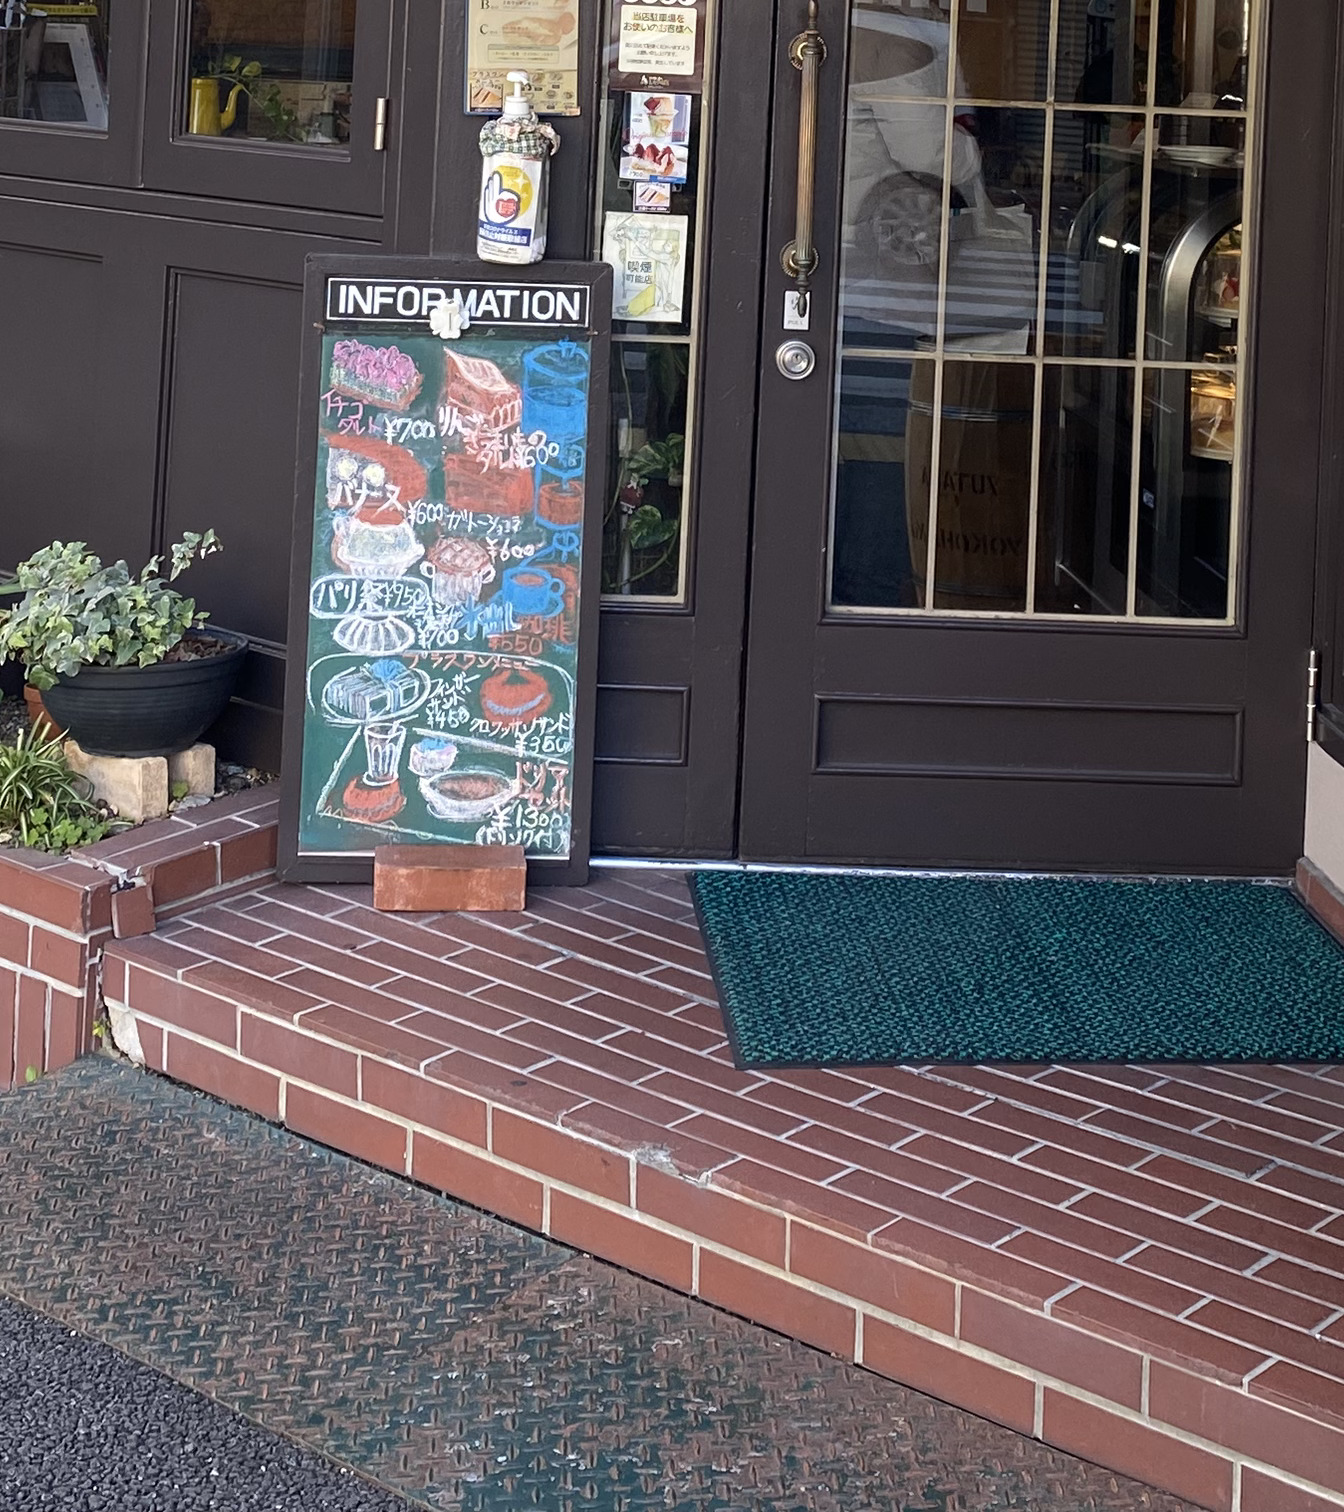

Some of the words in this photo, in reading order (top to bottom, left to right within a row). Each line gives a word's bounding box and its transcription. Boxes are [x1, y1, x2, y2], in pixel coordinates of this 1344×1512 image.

[481, 0, 490, 9] B
[480, 24, 489, 35] C
[627, 260, 652, 273] 喫煙
[339, 284, 580, 322] INFORMATION
